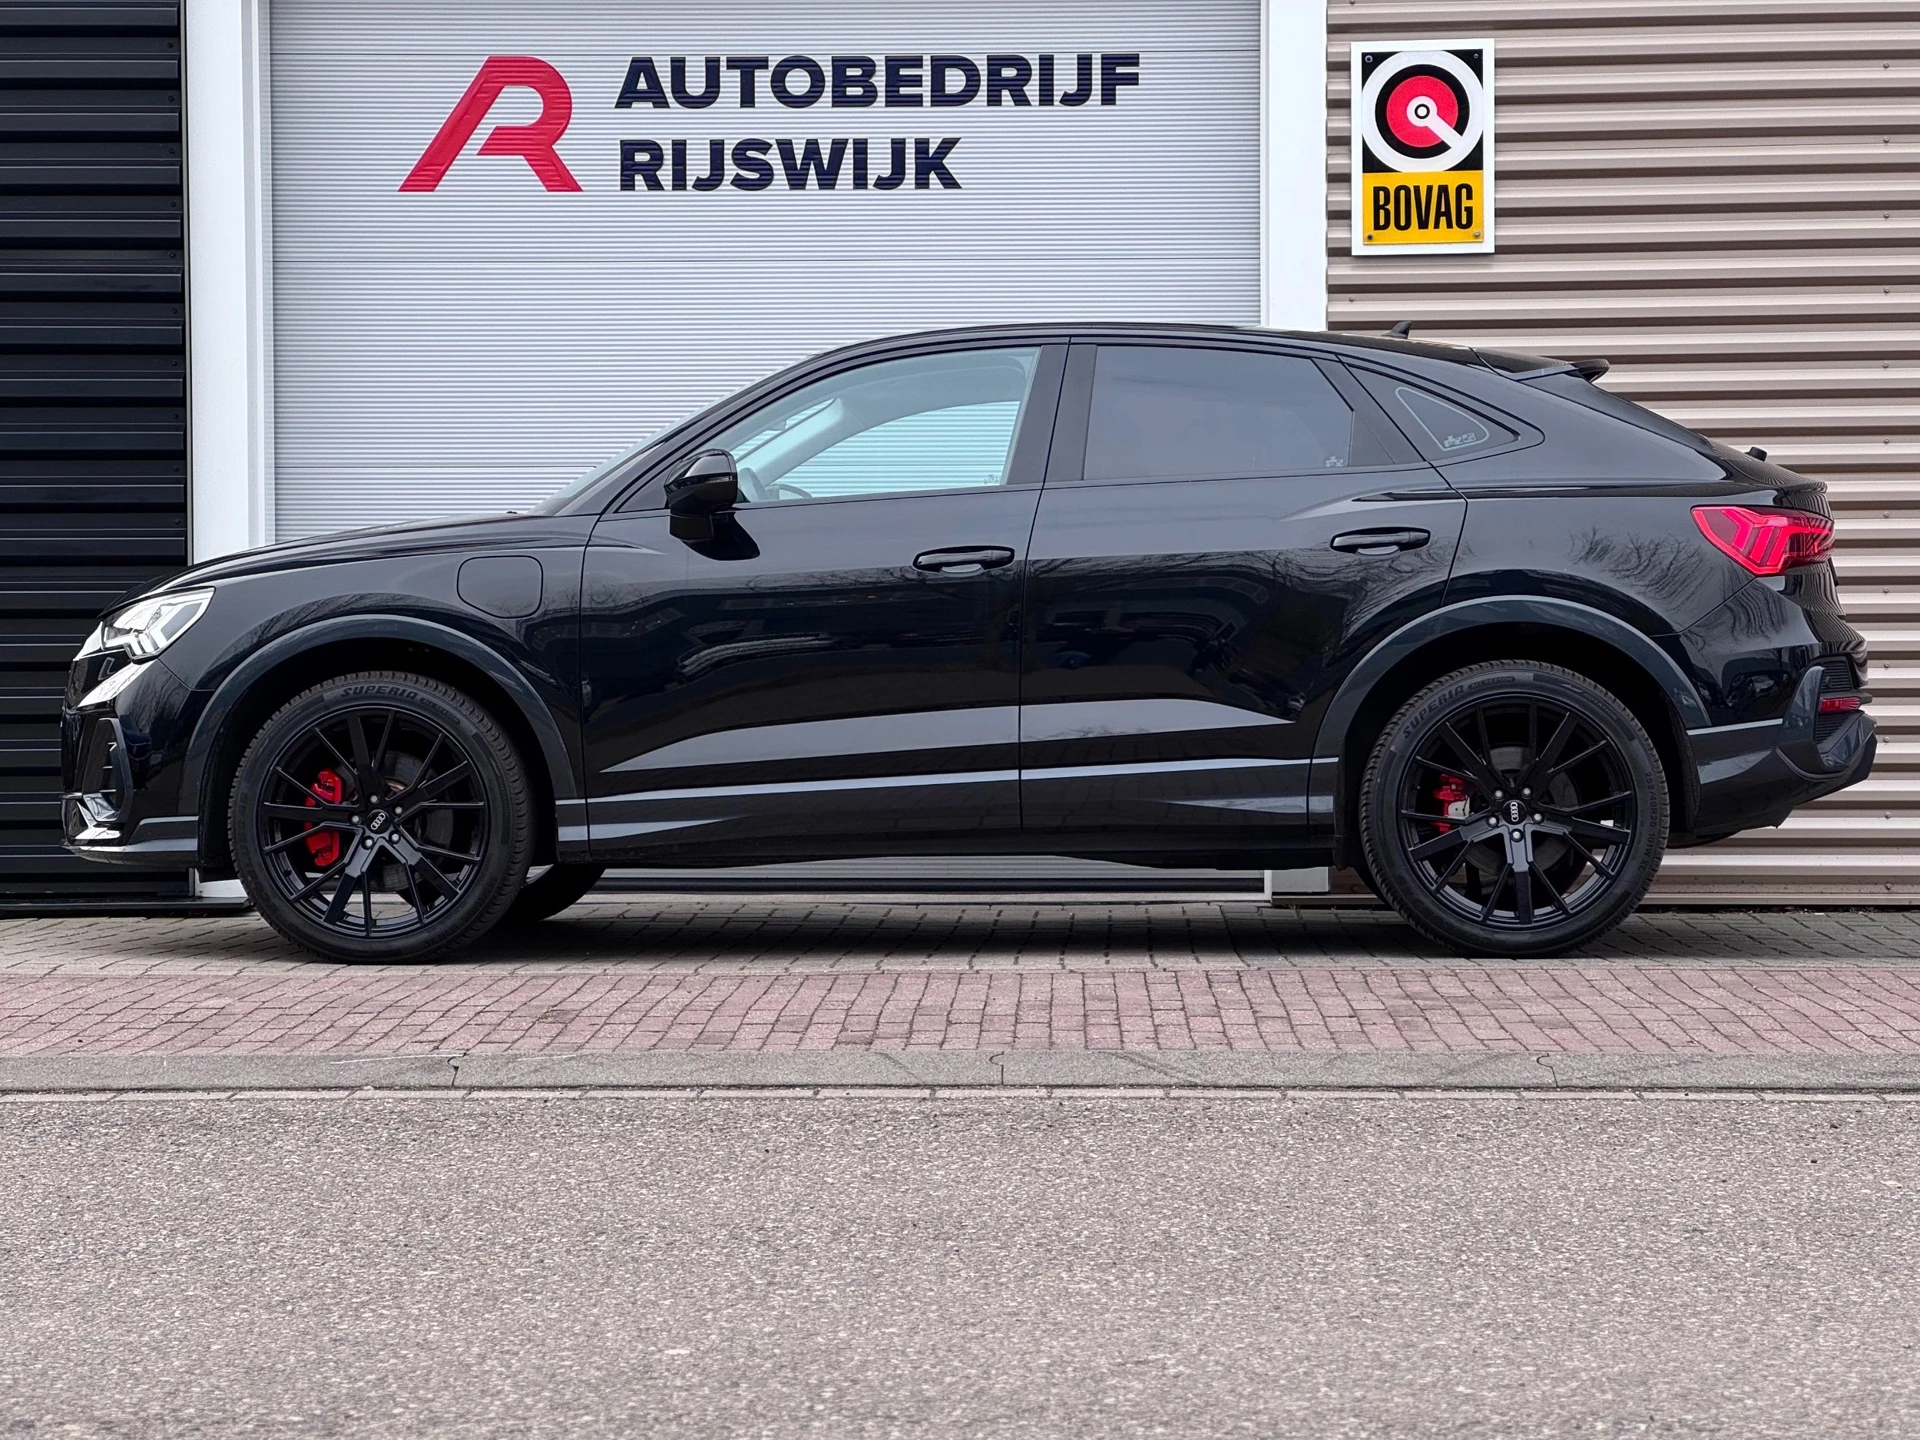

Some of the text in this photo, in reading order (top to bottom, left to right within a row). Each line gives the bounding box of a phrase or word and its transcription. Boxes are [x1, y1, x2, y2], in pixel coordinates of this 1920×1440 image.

[615, 52, 1140, 109] AUTOBEDRIJF
[619, 137, 963, 192] RIJSWIJK
[1373, 183, 1474, 231] BOVAG
[340, 685, 419, 700] SUPERIA
[1402, 683, 1465, 739] SUPERIA
